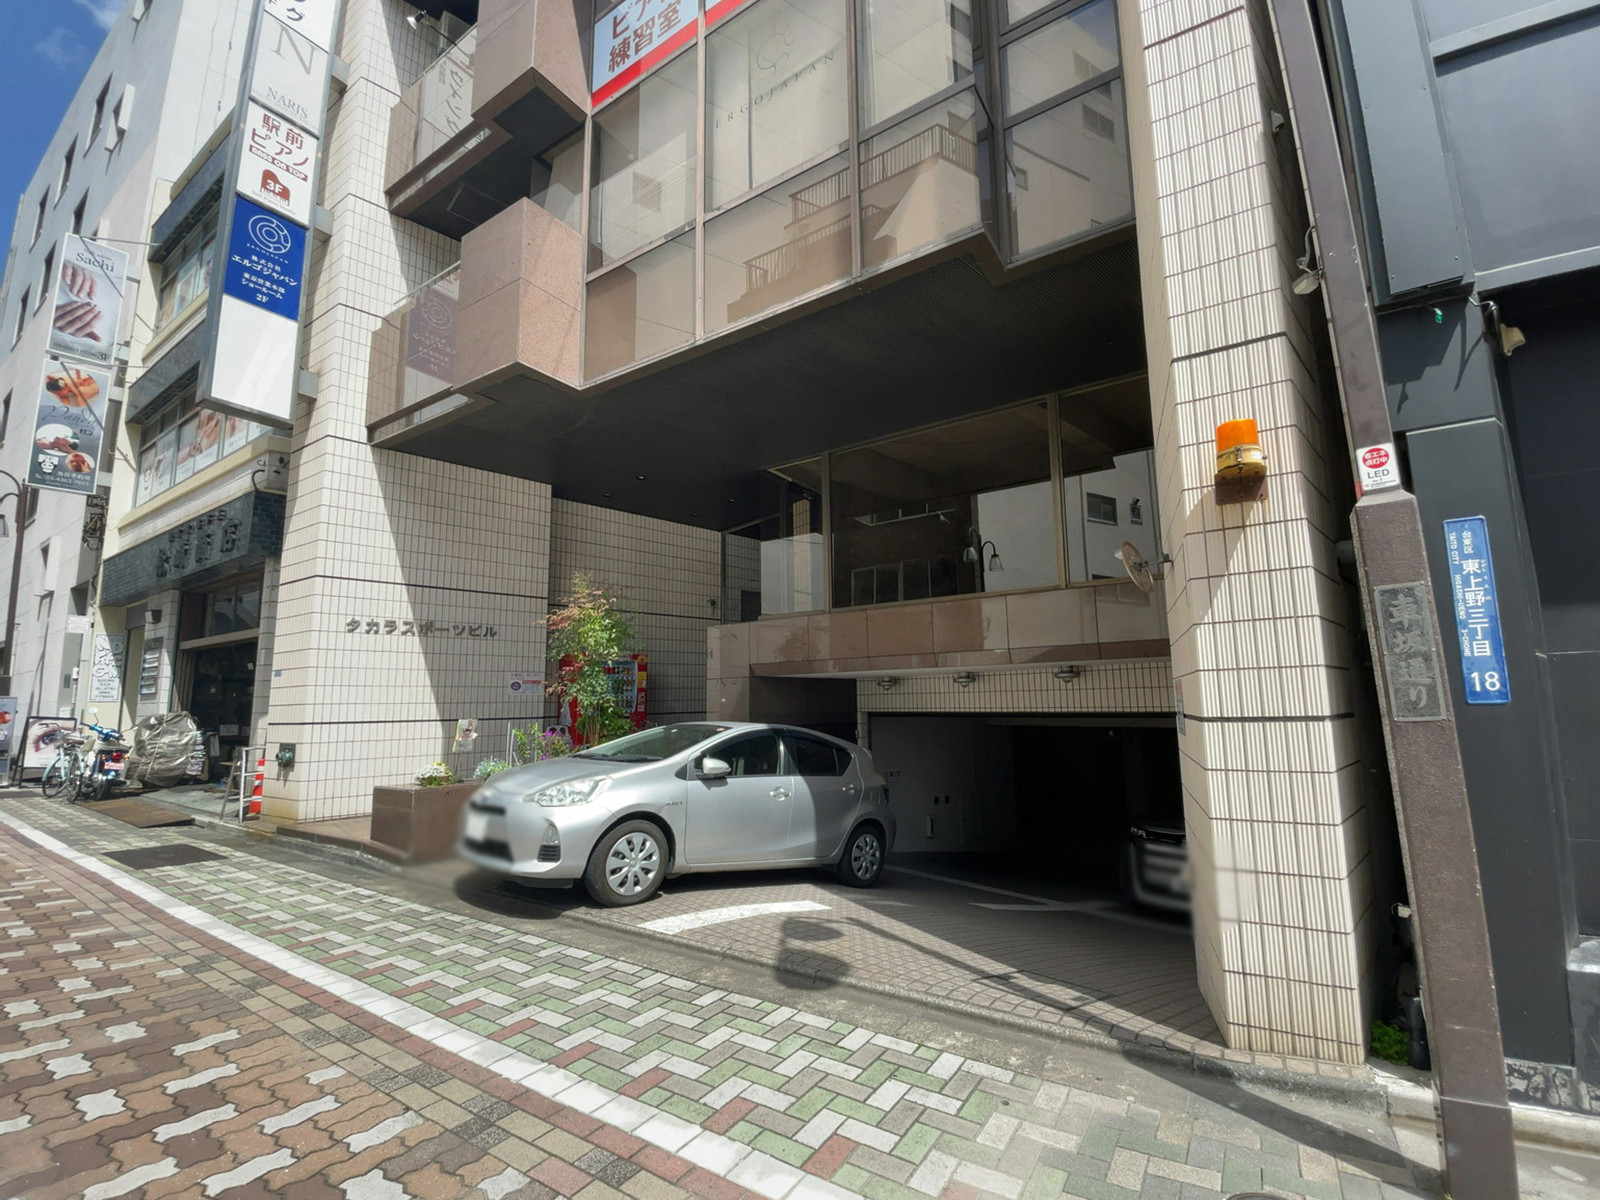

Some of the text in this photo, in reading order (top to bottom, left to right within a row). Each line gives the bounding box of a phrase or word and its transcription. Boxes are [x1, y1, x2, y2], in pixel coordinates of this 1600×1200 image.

[608, 0, 682, 73] 練習室
[267, 86, 308, 119] NARIS
[262, 113, 304, 150] 駅前
[251, 127, 309, 167] ピアノ
[288, 166, 307, 180] TOP
[265, 179, 285, 195] 3F
[75, 251, 115, 273] Sachi
[232, 255, 298, 286] エルゴジャパン
[251, 255, 281, 272] 株式会社
[241, 278, 283, 300] ショールーム
[256, 293, 269, 303] 2F
[1367, 468, 1390, 479] LED
[1460, 558, 1491, 657] 東上野三丁目
[346, 616, 498, 638] タカラスポーツビル
[1461, 628, 1472, 658] 3-CHOME
[1470, 671, 1501, 692] 18
